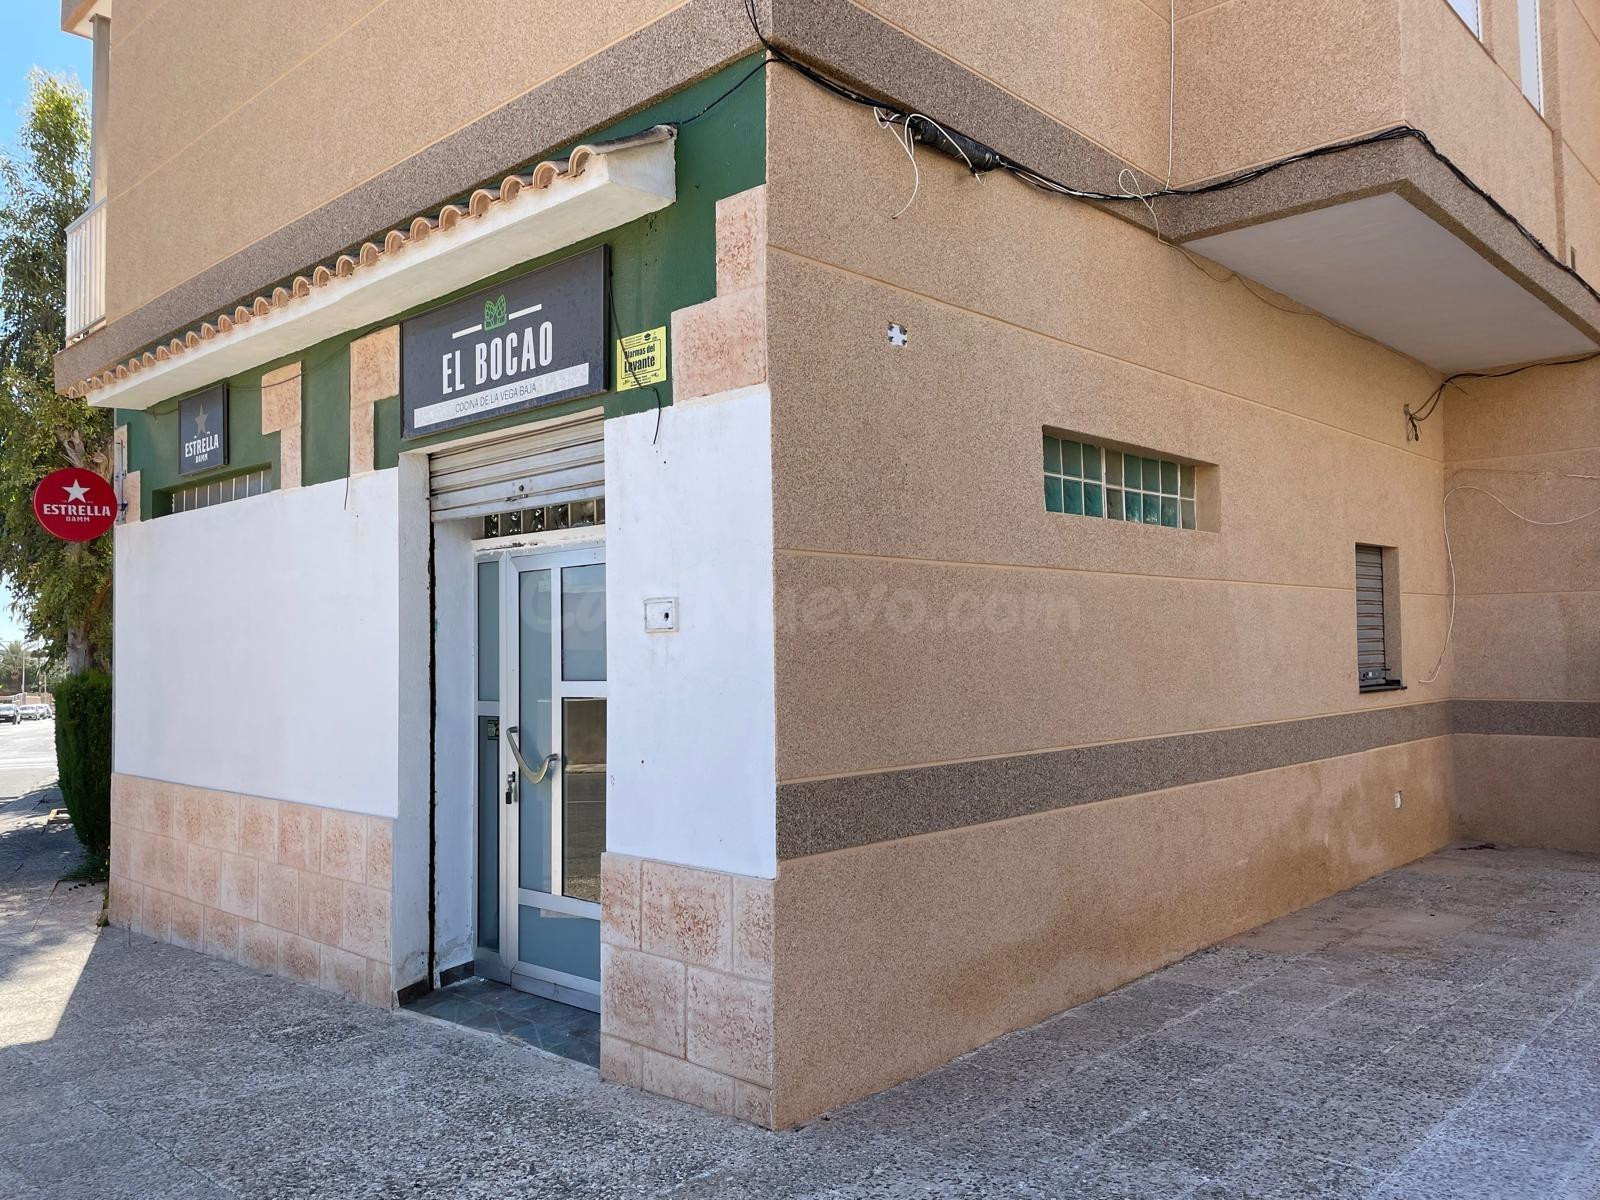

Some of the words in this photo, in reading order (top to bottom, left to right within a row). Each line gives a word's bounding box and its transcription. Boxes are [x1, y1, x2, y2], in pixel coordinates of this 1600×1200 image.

[442, 350, 464, 394] EL
[476, 321, 552, 385] BOCAO
[646, 344, 656, 354] del
[455, 397, 479, 413] COCINA
[480, 395, 489, 406] DE
[490, 392, 499, 404] LA
[500, 387, 519, 401] VEGA
[520, 382, 537, 397] BAJA
[184, 434, 219, 458] ESTRELLA
[195, 453, 208, 463] DAMM
[43, 504, 111, 516] ESTRELLA
